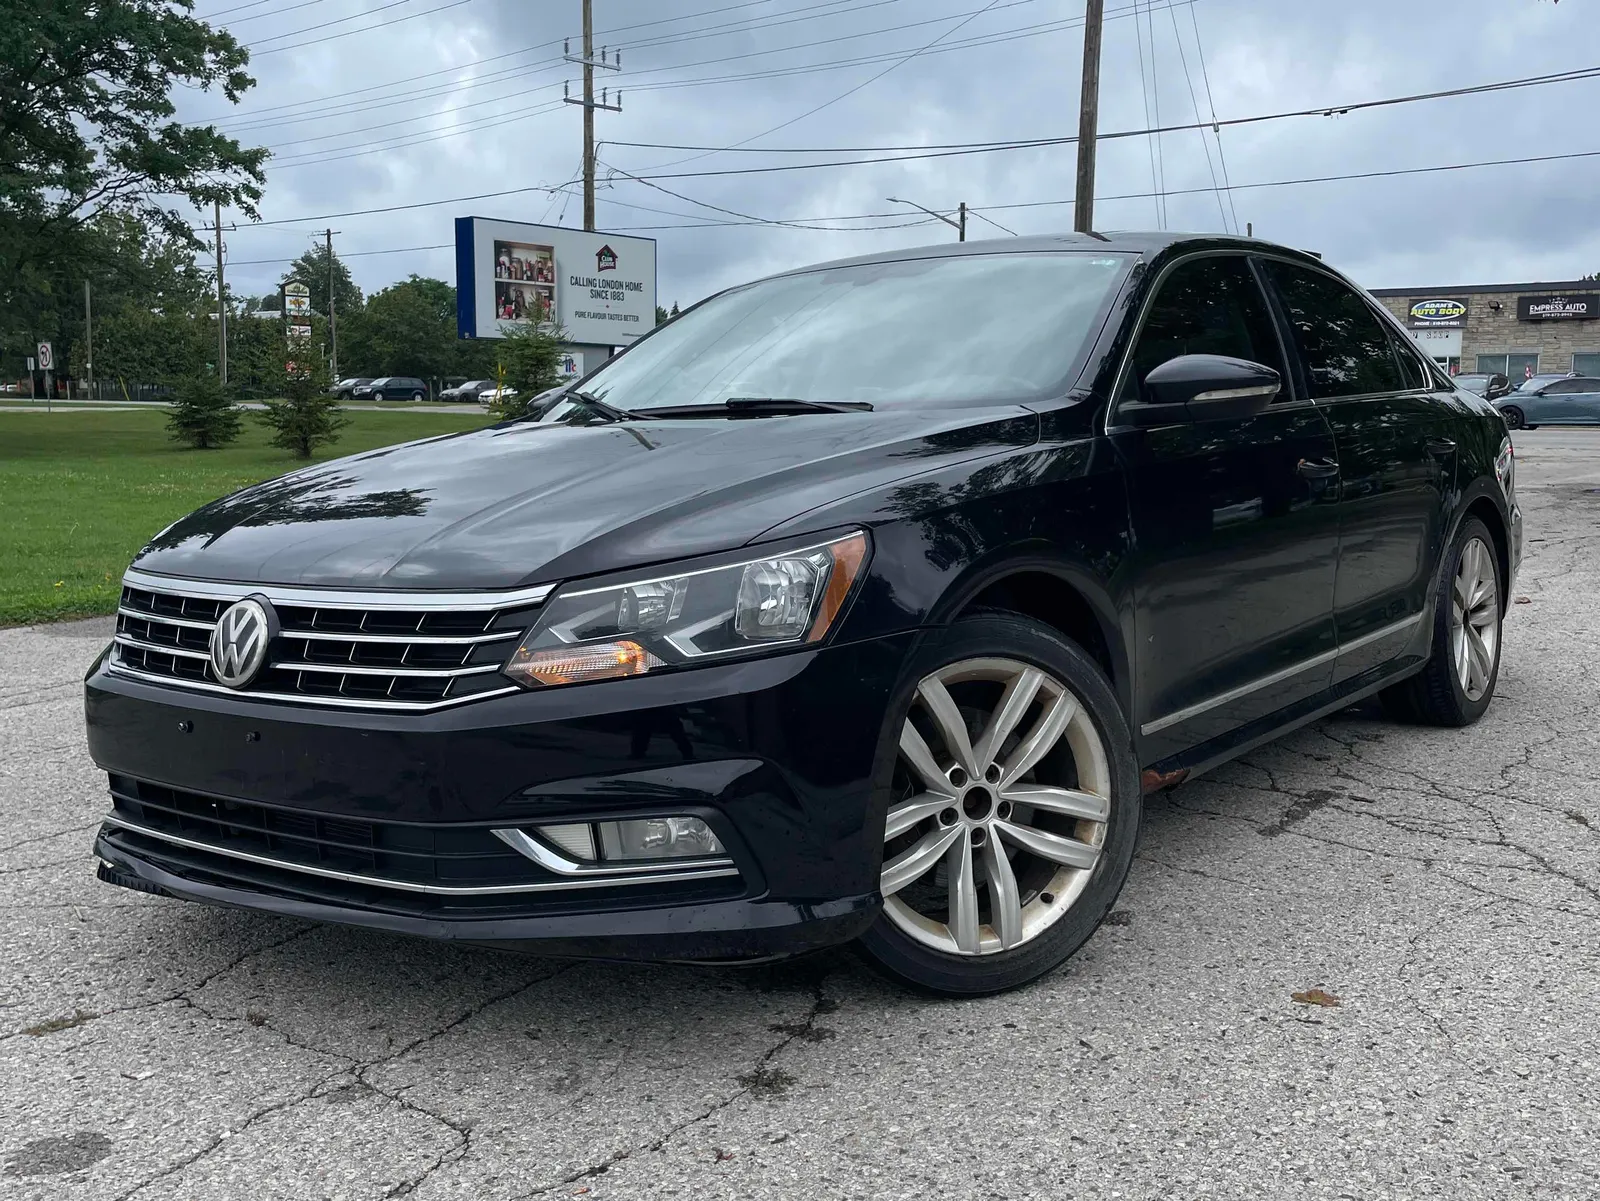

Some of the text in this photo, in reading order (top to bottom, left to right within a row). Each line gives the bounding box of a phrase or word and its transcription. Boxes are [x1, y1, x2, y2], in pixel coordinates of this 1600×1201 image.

[570, 275, 643, 292] CALLING LONDON HOME
[590, 289, 625, 301] SINCE 1883
[1530, 303, 1587, 313] EMPRESS AUTO
[574, 310, 587, 319] PURE
[587, 312, 607, 320] FLAVOUR
[607, 313, 623, 321] TASTES
[213, 603, 265, 684] VW
